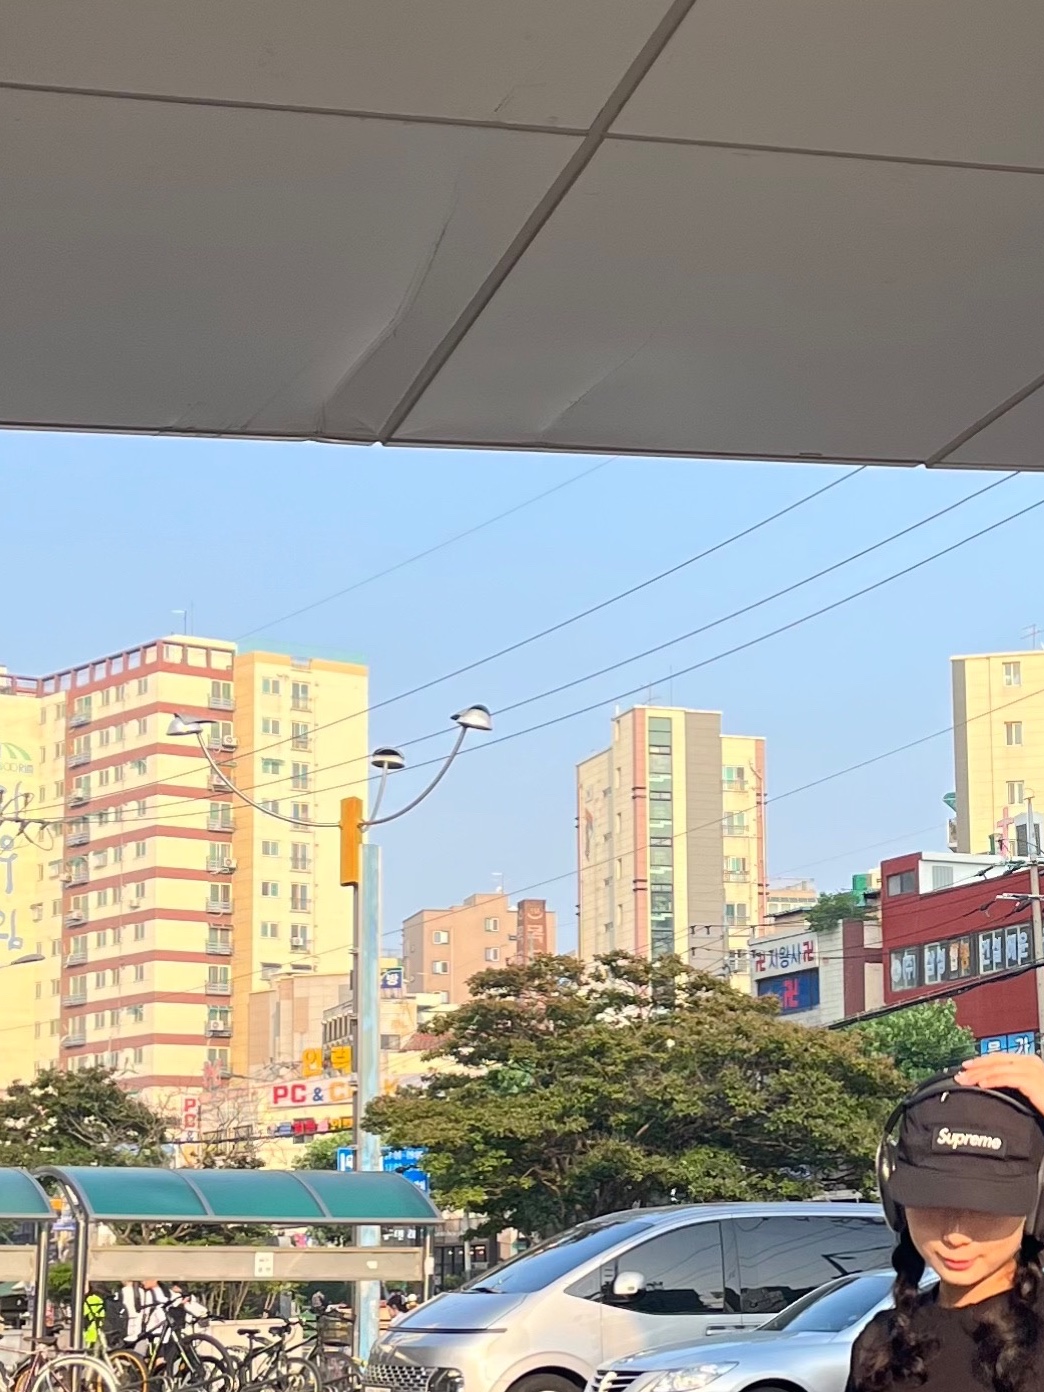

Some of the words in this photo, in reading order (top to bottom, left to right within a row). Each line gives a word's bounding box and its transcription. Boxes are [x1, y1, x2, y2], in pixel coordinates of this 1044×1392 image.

[273, 1084, 307, 1104] PC
[312, 1087, 324, 1101] &
[937, 1127, 1002, 1150] Supreme
